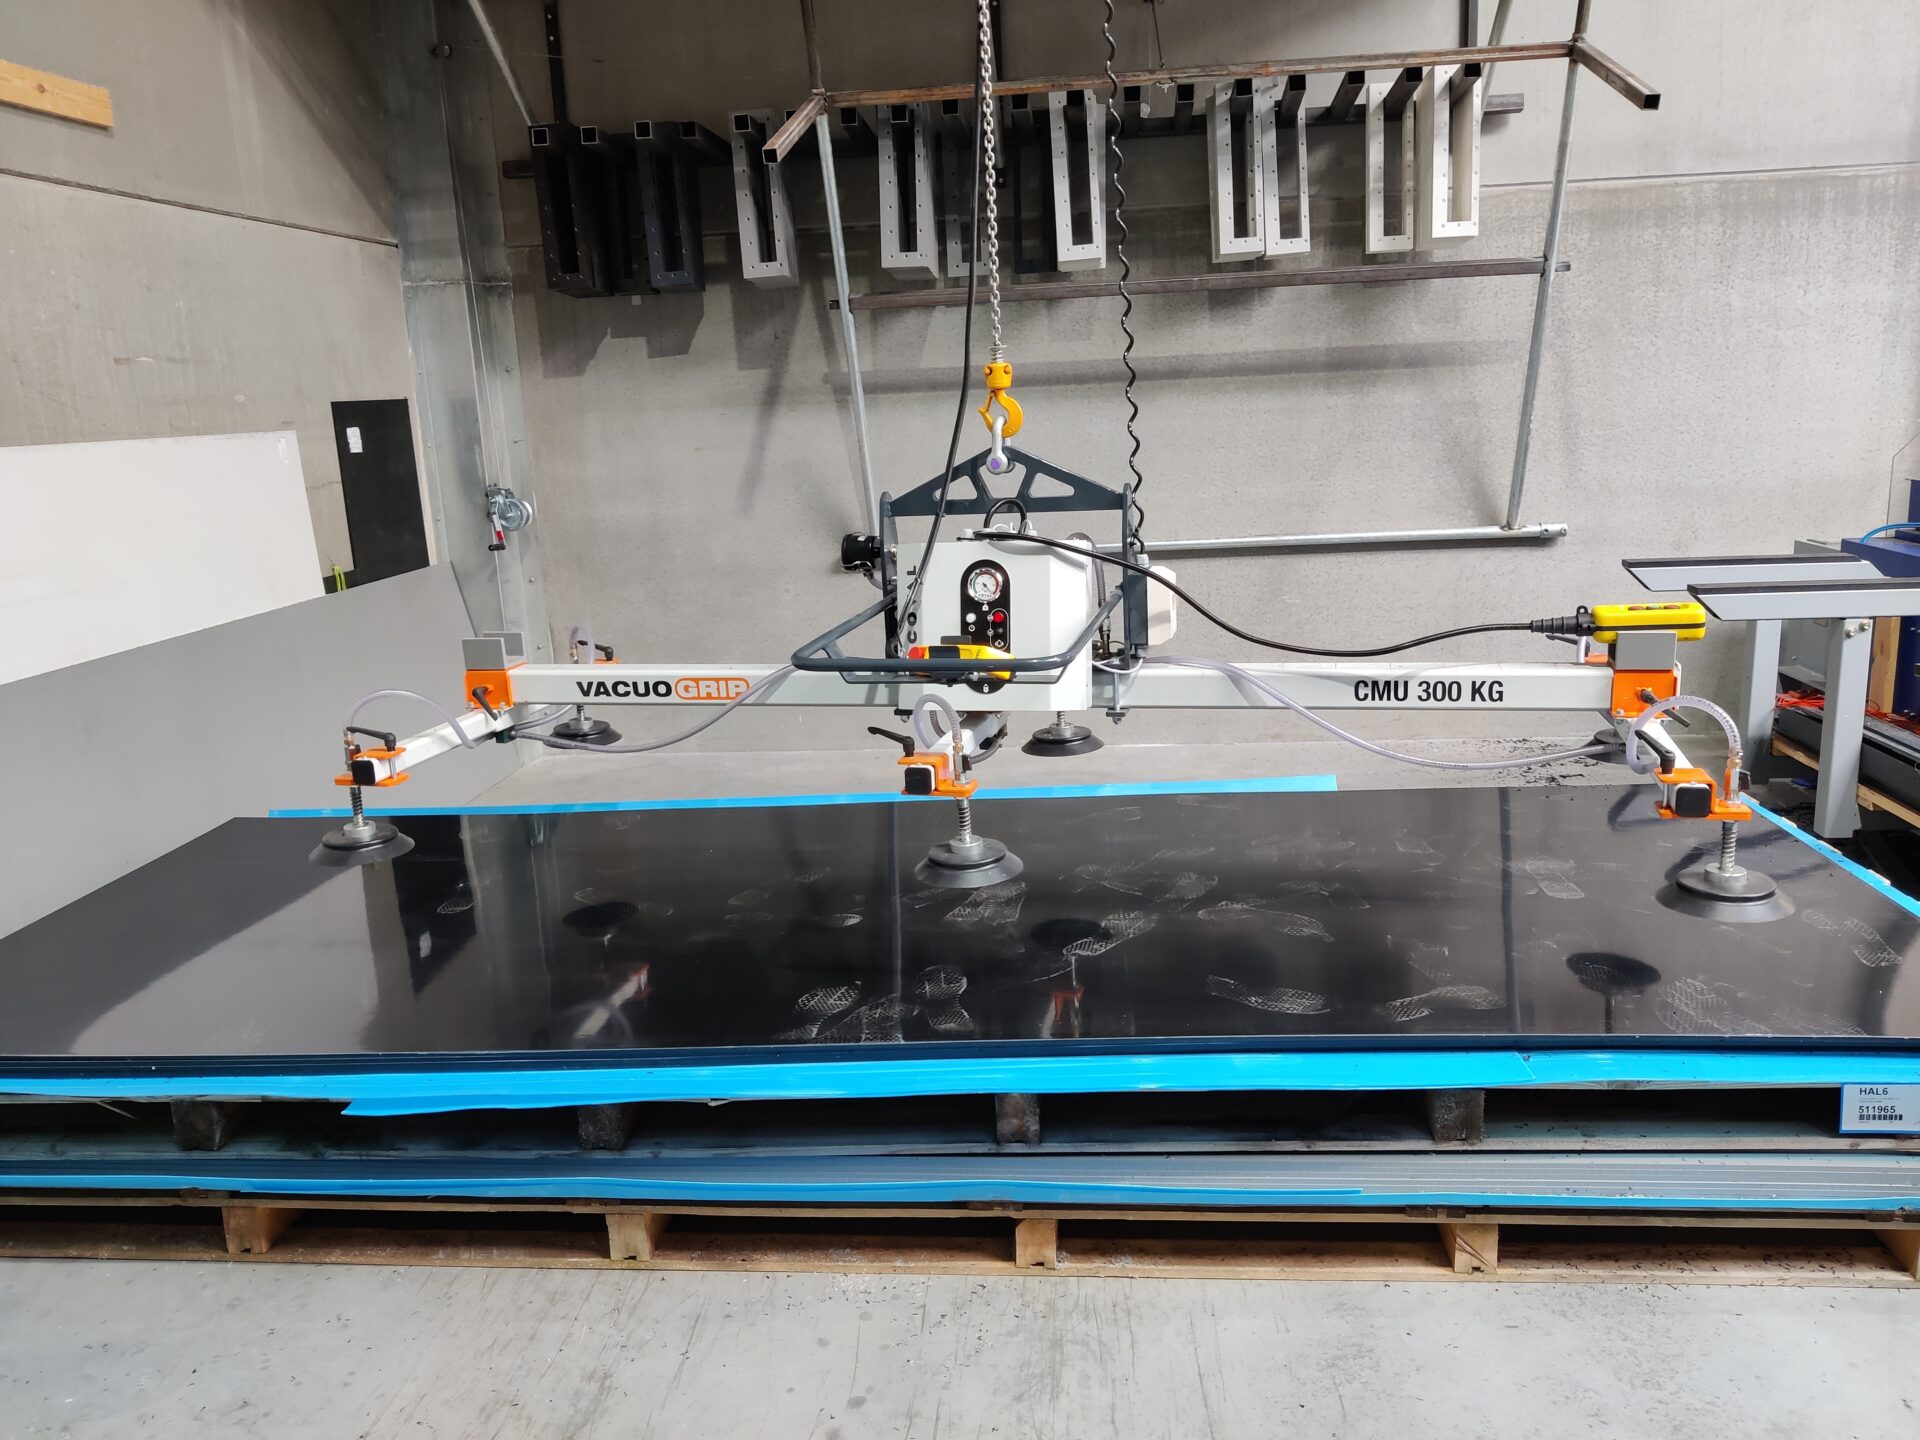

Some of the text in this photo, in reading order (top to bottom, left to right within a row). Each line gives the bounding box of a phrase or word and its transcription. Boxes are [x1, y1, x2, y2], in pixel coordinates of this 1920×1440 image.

[575, 680, 748, 698] VACUO GRIP
[1353, 679, 1504, 702] CMU 300 KG
[1859, 1087, 1889, 1096] HAL6
[1858, 1105, 1896, 1114] 511965
